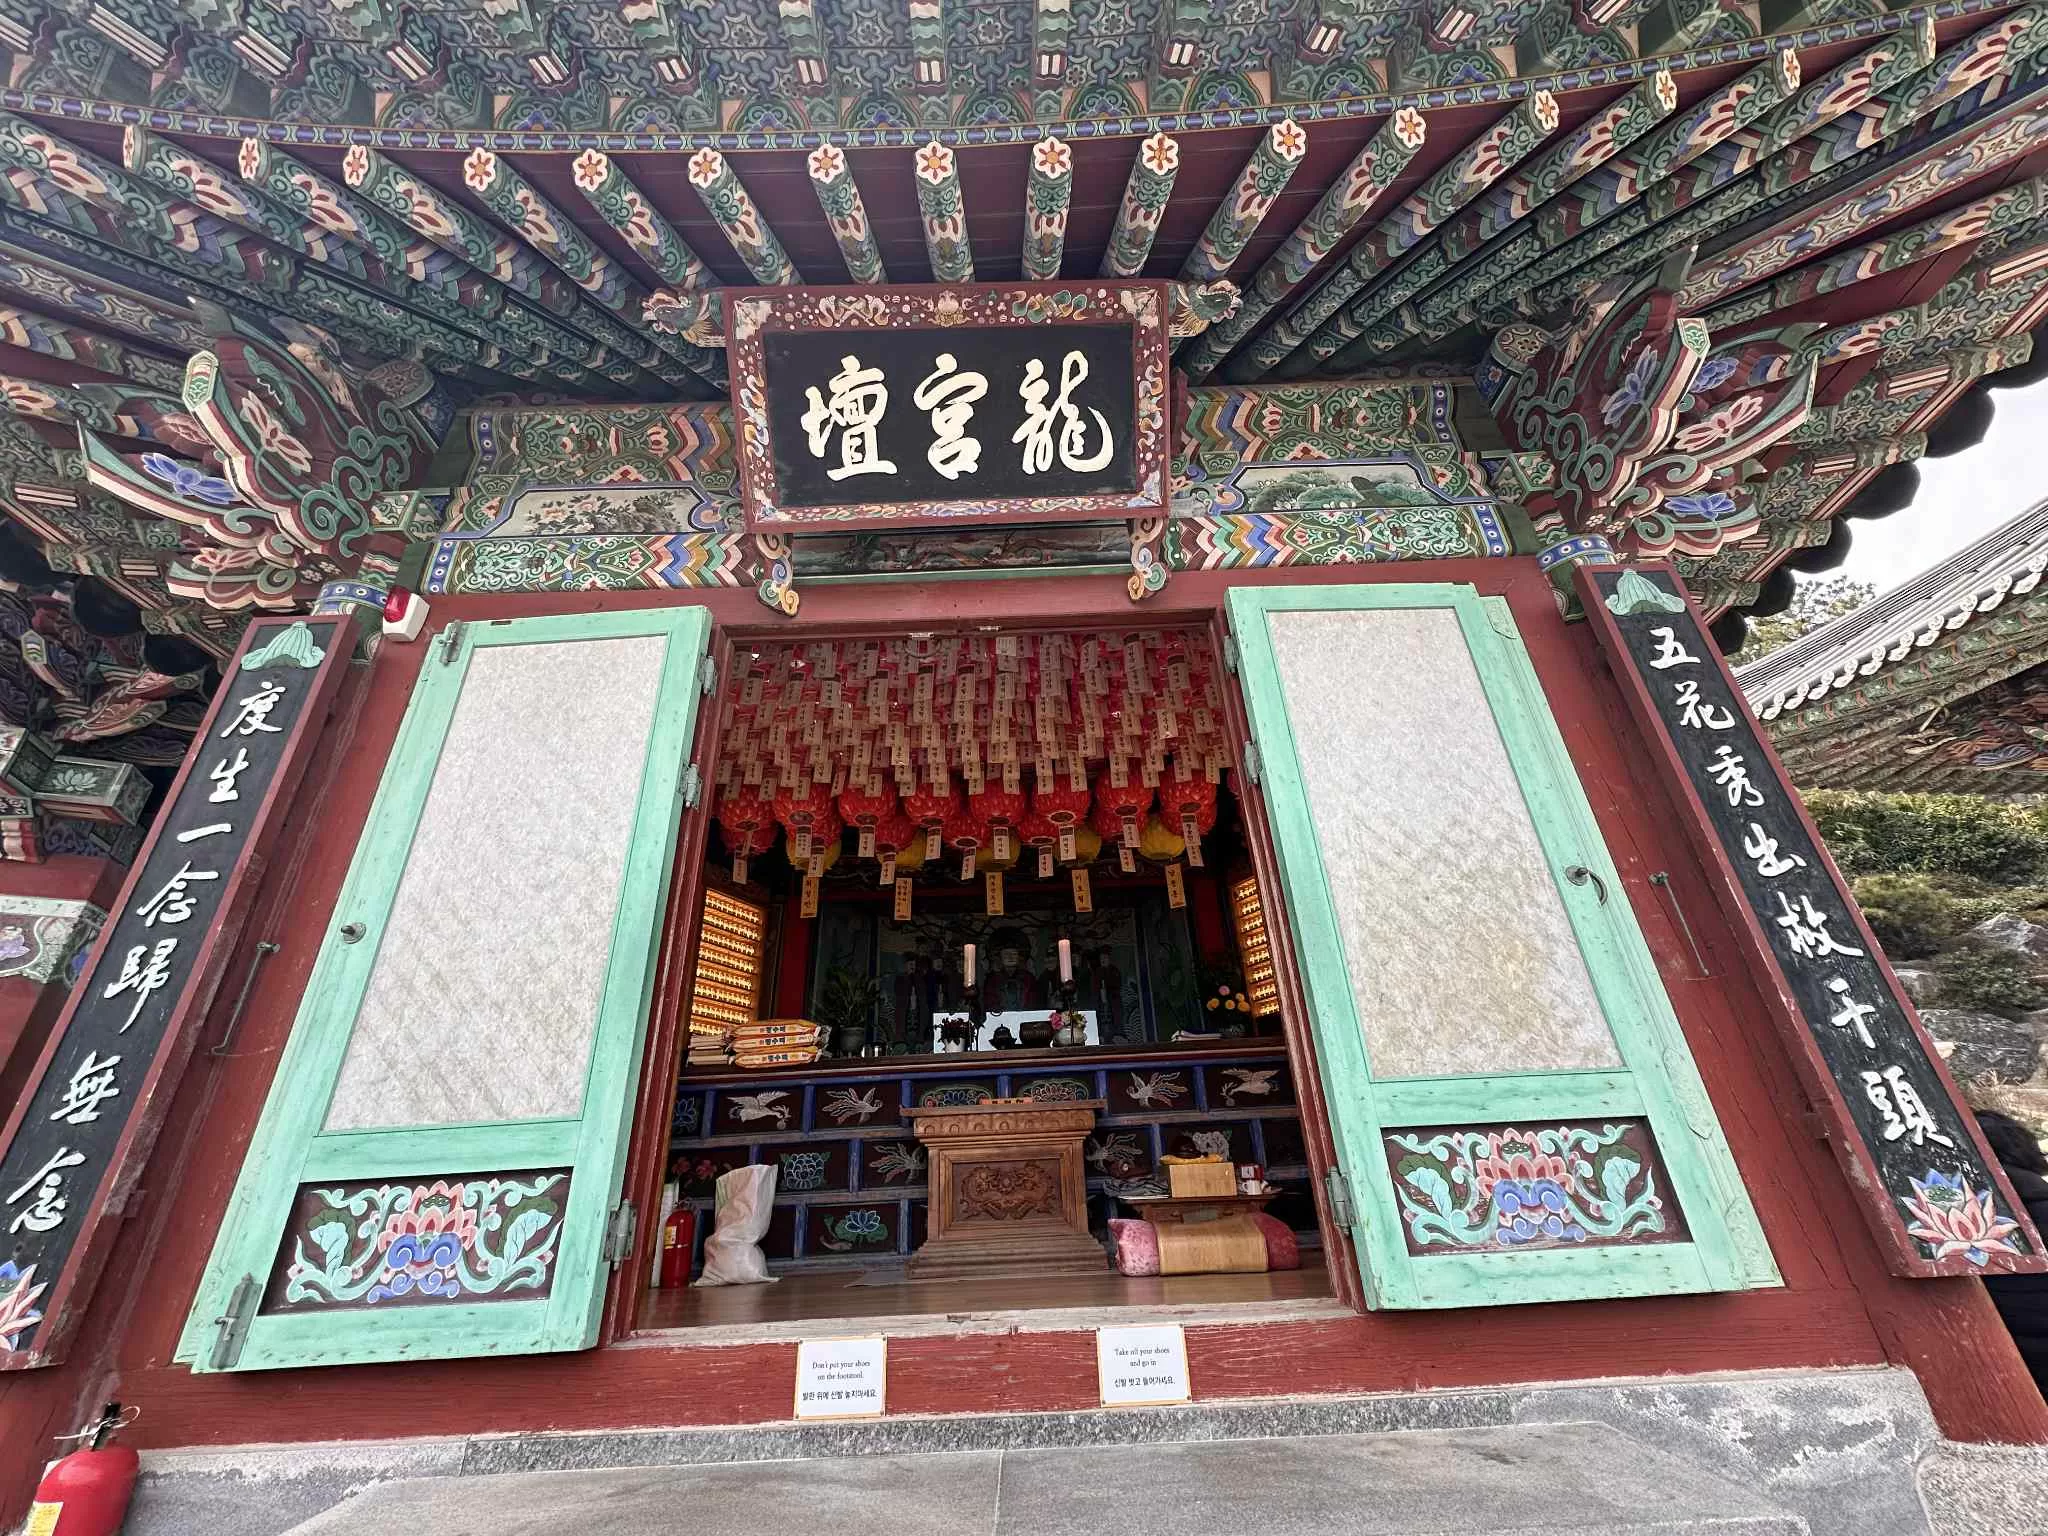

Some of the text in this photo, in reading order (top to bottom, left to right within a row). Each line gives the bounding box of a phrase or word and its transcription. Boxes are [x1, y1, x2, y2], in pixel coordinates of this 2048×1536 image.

[1114, 1348, 1128, 1356] Take
[1130, 1347, 1139, 1355] off
[1140, 1349, 1153, 1357] your
[812, 1359, 871, 1371] Don't put your shoes
[1129, 1359, 1141, 1367] and
[1141, 1360, 1150, 1368] go
[1114, 1377, 1127, 1388] 신발
[1128, 1377, 1141, 1387] 벗고
[802, 1391, 815, 1401] 발판
[816, 1391, 830, 1401] 위에
[830, 1390, 844, 1400] 신발
